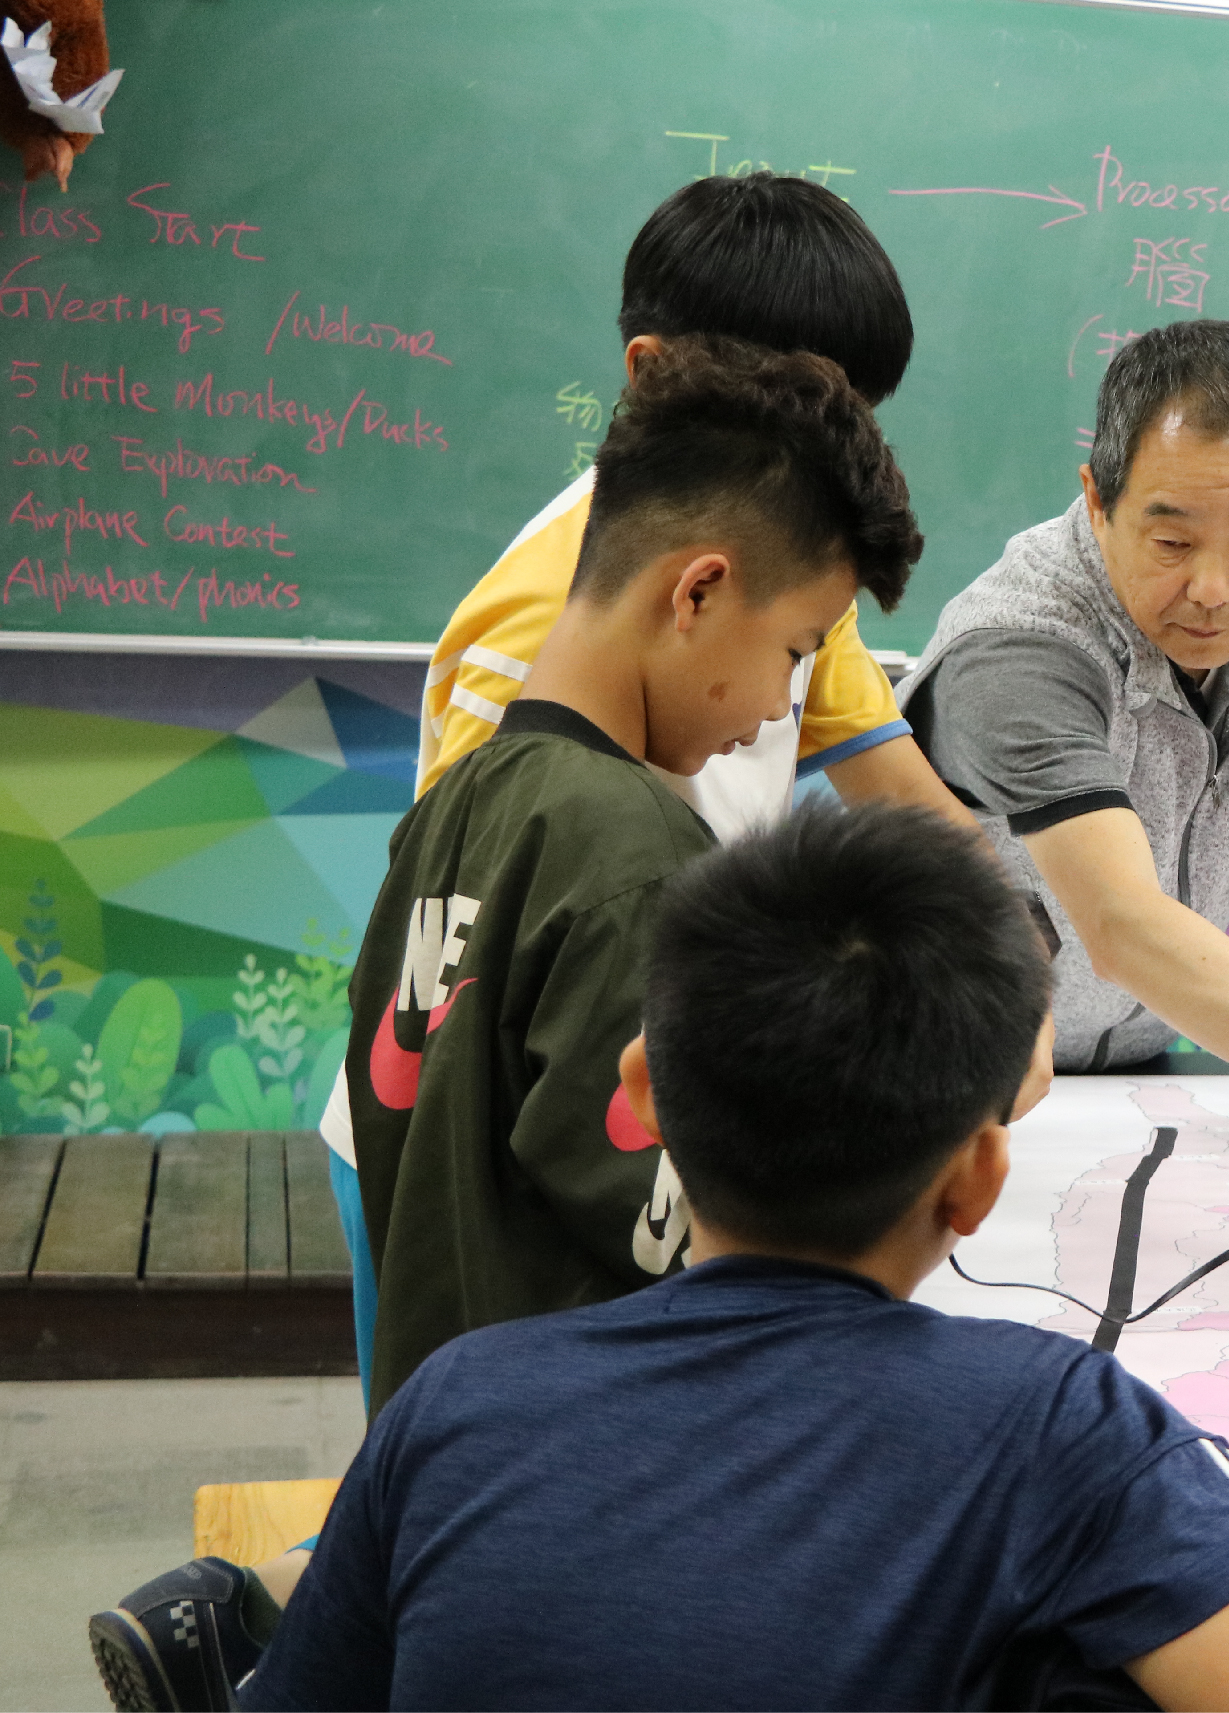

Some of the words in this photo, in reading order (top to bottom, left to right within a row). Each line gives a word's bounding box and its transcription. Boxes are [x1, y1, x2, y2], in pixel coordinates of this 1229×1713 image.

[0, 186, 102, 243] lass
[126, 182, 266, 262] Start
[0, 255, 226, 354] Greetings
[9, 361, 41, 399] 5
[60, 366, 158, 413] little
[111, 435, 318, 499] Exploration
[9, 491, 149, 556] Airplane
[163, 504, 296, 558] Contest
